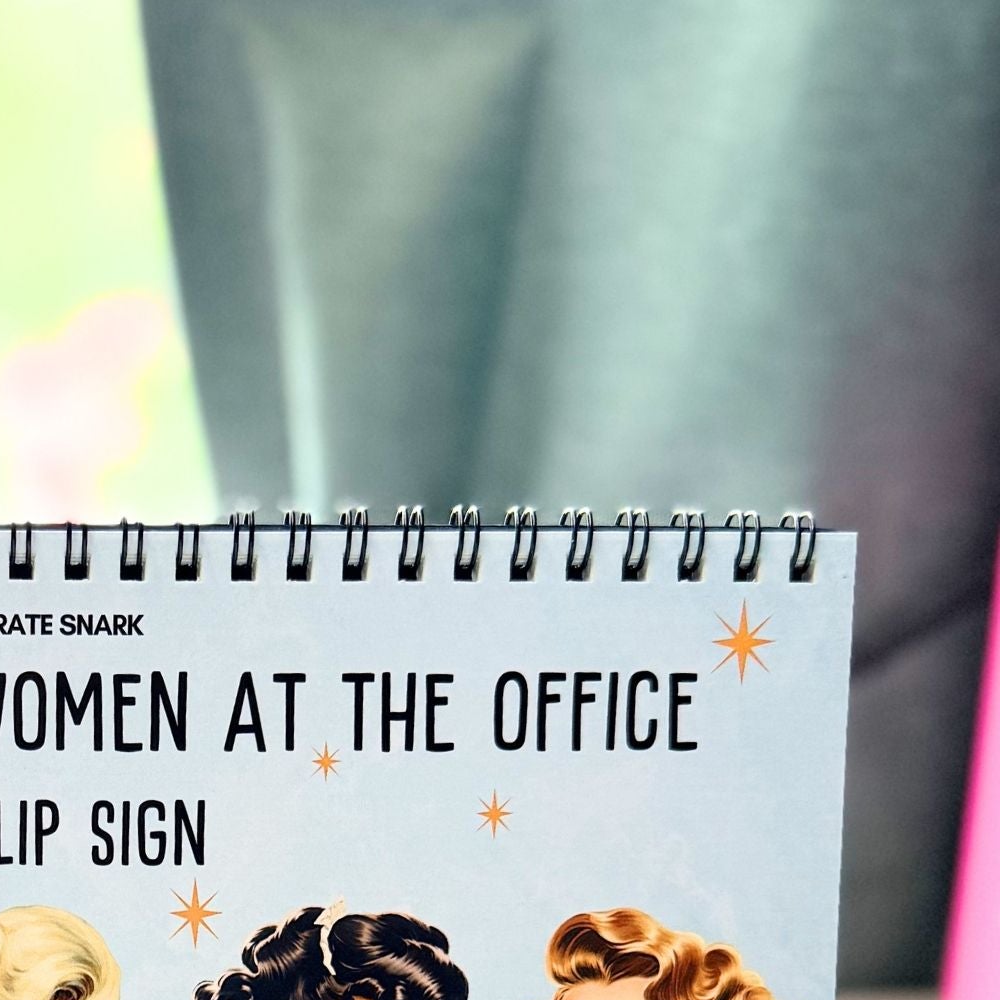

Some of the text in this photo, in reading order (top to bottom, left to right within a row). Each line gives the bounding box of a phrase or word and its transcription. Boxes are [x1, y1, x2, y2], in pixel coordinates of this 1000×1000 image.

[59, 613, 145, 636] SNARK
[223, 671, 307, 753] AT
[341, 671, 455, 753] THE
[493, 670, 698, 752] OFFICE
[91, 799, 206, 867] SIGN
